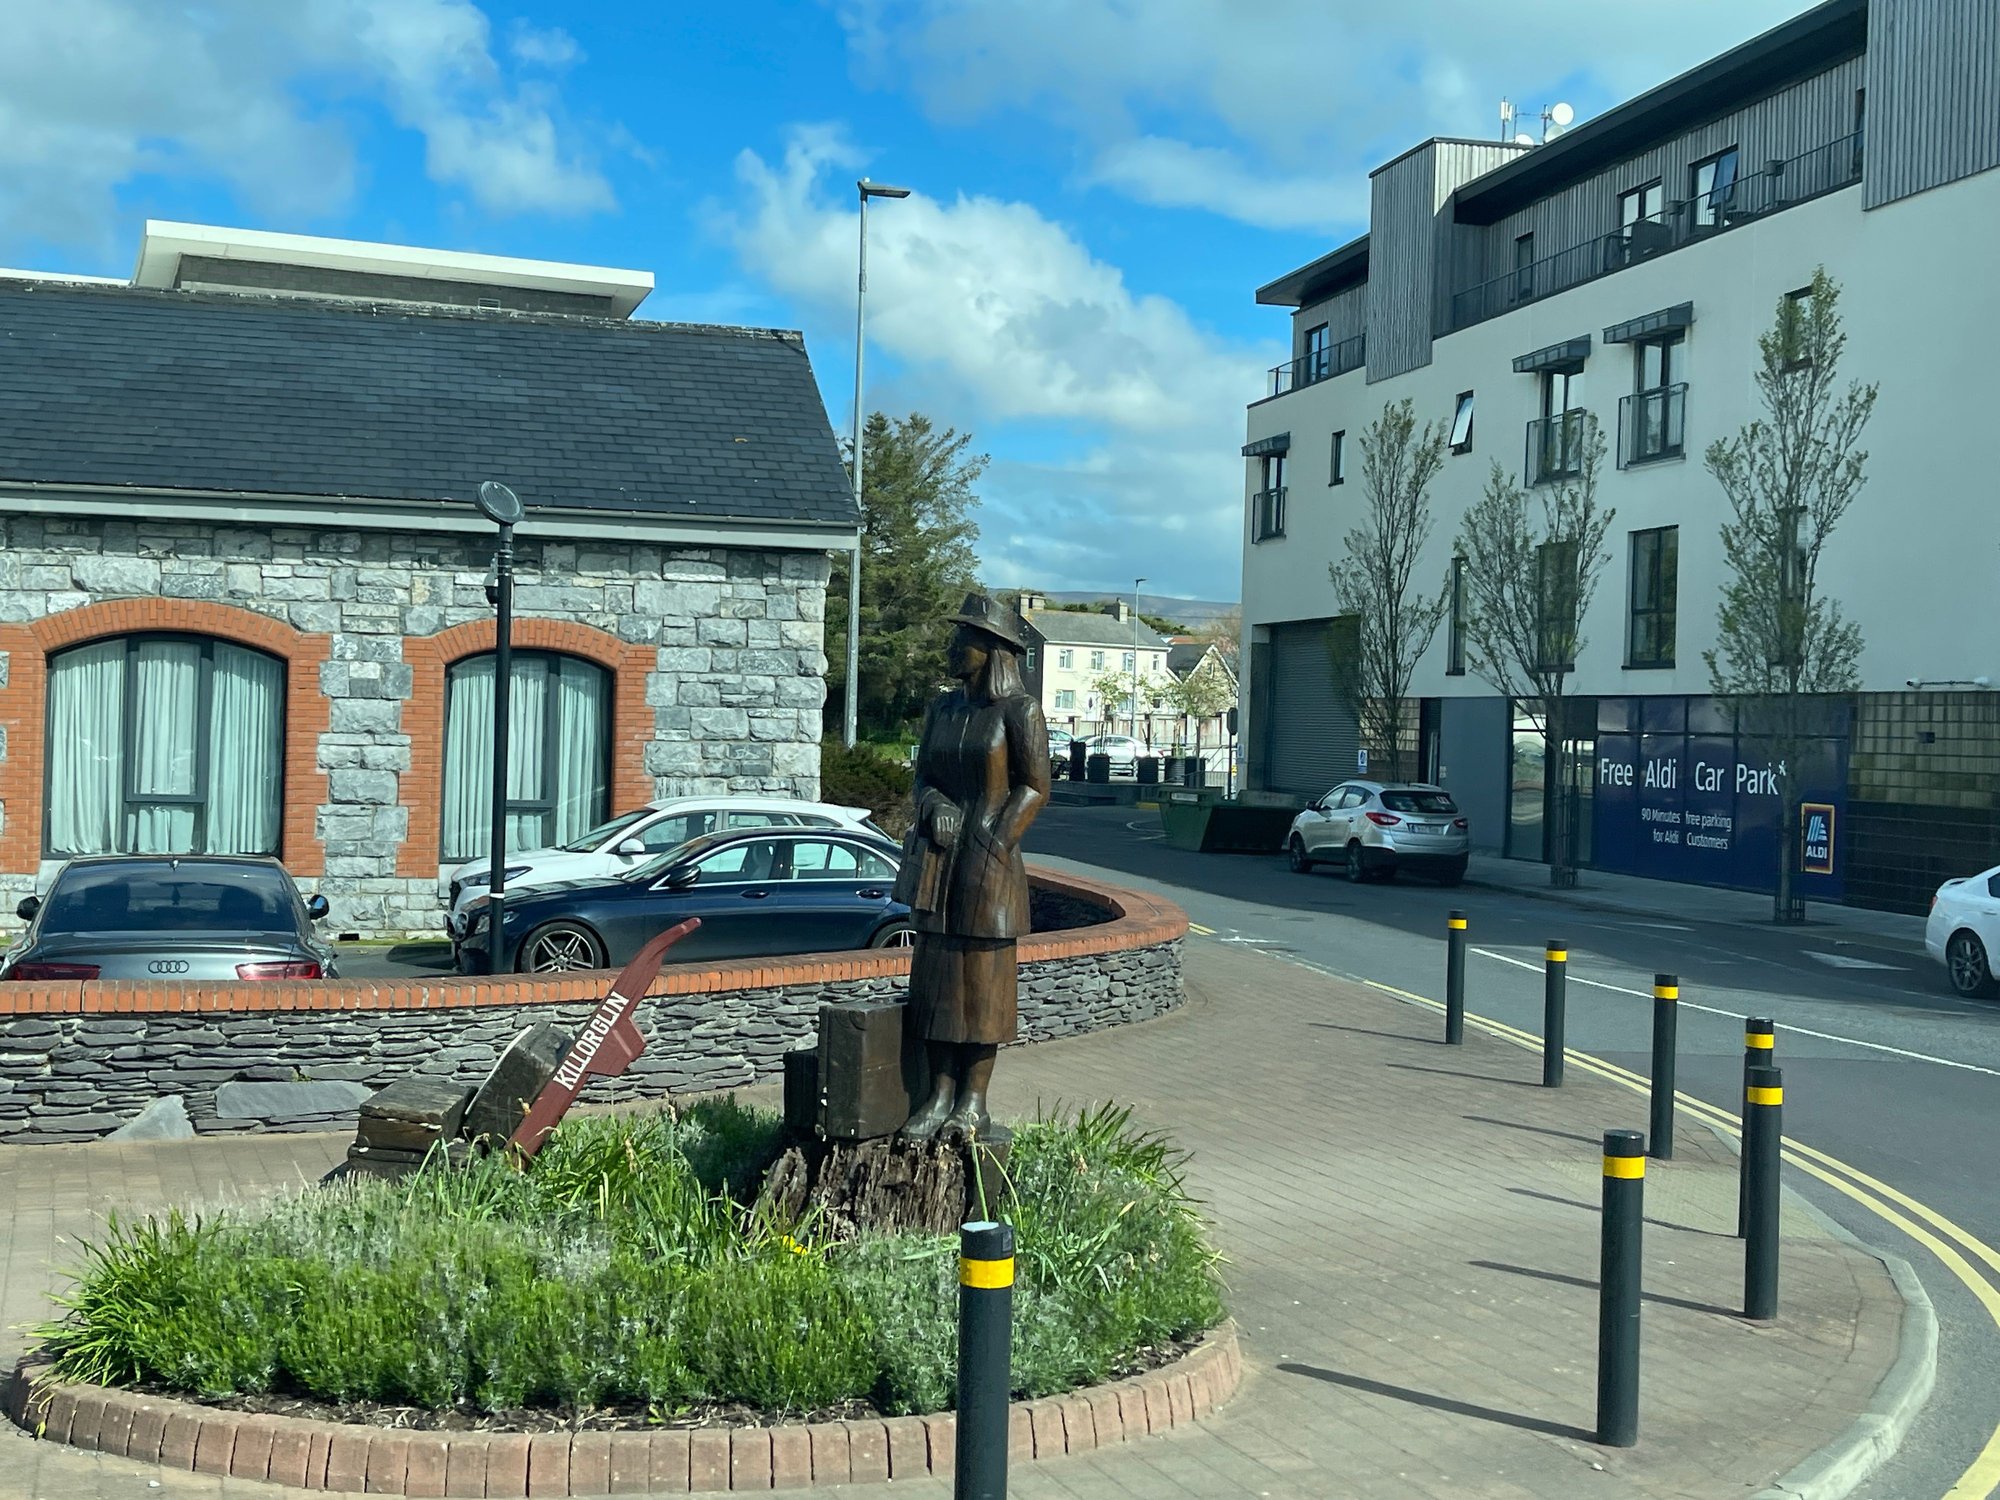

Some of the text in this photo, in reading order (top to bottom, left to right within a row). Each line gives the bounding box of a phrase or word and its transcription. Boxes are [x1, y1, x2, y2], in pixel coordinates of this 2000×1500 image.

[1601, 757, 1633, 786] Free
[1645, 758, 1677, 789] Aldi
[1695, 762, 1725, 791] Car
[1641, 807, 1732, 832] 90 Minutes free parking
[1653, 828, 1728, 850] for Aldi Customers
[1806, 845, 1827, 859] ALDI
[553, 991, 629, 1090] KILLORGLIN
